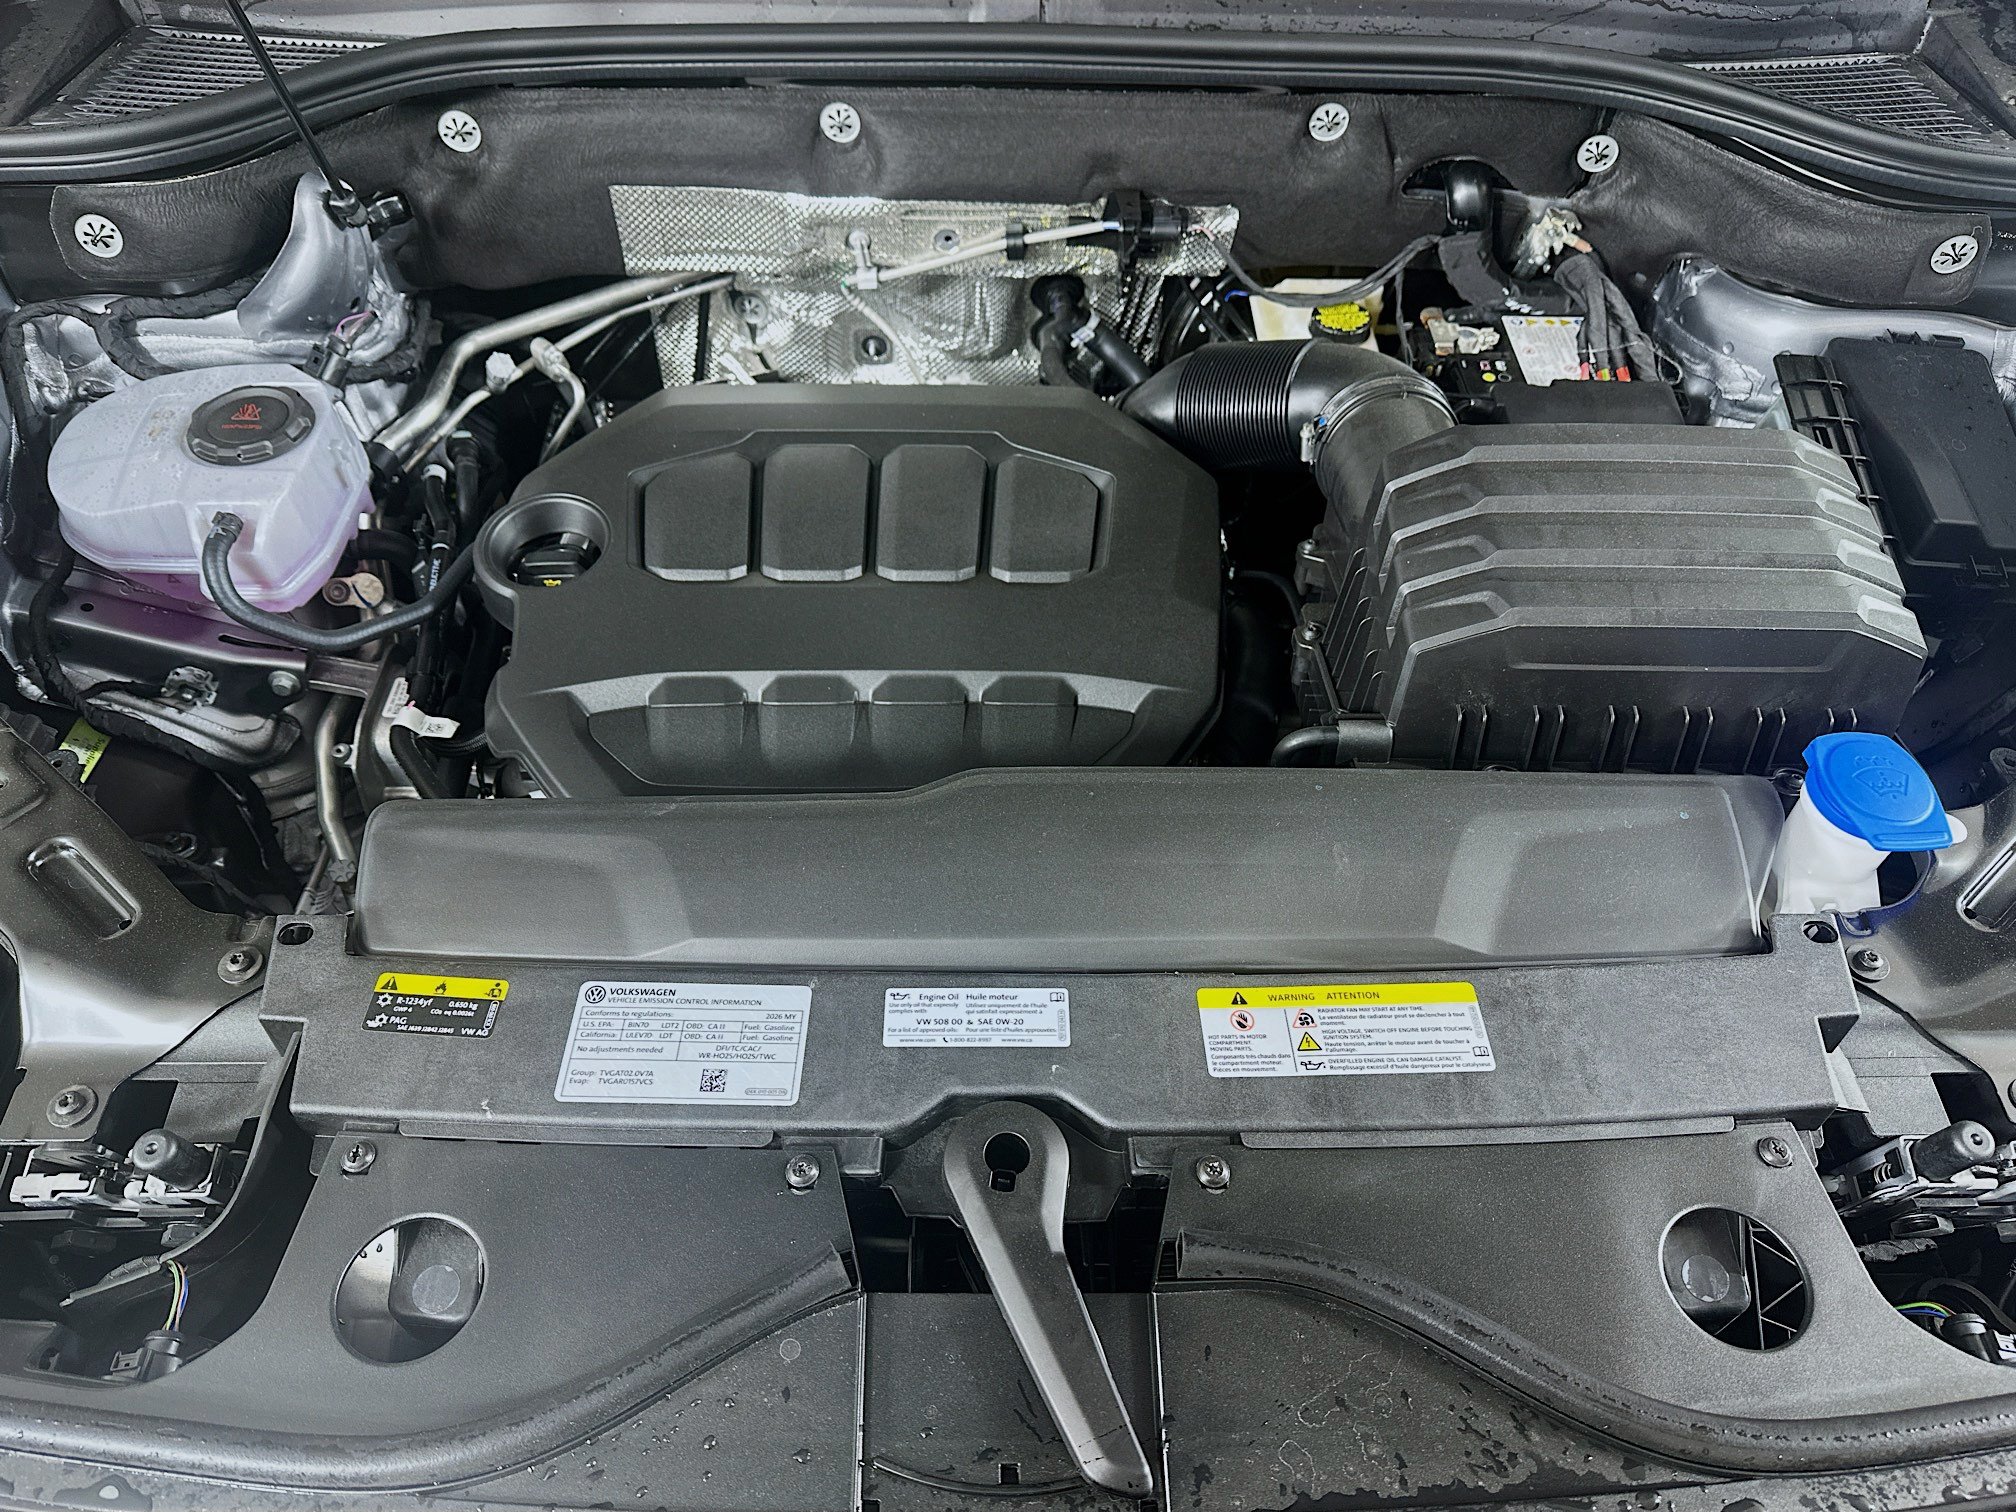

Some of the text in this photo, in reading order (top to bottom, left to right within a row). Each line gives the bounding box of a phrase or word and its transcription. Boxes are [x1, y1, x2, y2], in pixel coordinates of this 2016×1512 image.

[609, 988, 677, 997] VOLKSWAGEN
[919, 994, 946, 1002] Engine
[1267, 992, 1380, 1002] WARNING ATTENTION
[396, 997, 434, 1007] R-1234yf
[468, 1002, 479, 1010] kg
[585, 1009, 620, 1017] Conforms
[630, 1010, 674, 1020] regulations:
[389, 1016, 407, 1025] PAG
[461, 1028, 476, 1036] VW
[588, 1046, 636, 1054] adjustments
[570, 1069, 597, 1077] Group:
